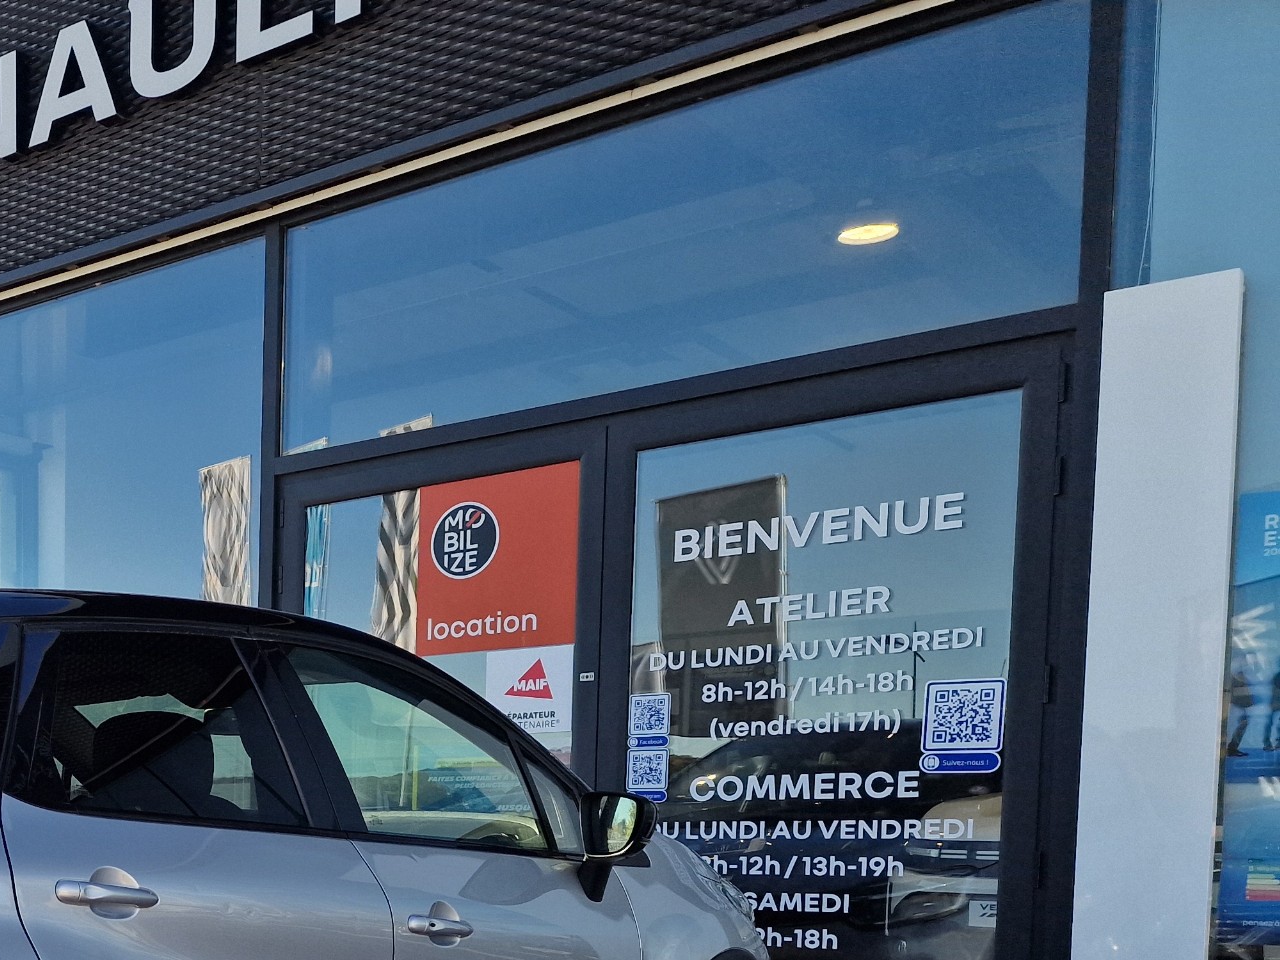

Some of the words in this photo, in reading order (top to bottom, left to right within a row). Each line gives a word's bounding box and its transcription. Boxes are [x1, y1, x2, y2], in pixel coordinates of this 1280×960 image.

[673, 492, 966, 564] BIENVENUE
[727, 586, 892, 628] ATELIER
[426, 610, 538, 641] location
[649, 650, 686, 672] DU
[691, 644, 772, 669] LUNDI
[778, 639, 820, 663] AU
[825, 627, 984, 660] VENDREDI
[512, 678, 549, 692] MAIF
[701, 678, 787, 704] 8h-12h
[810, 670, 914, 697] 14h-18h
[507, 710, 556, 721] ÉPARATEUR
[709, 713, 840, 741] (vendredi
[846, 708, 902, 737] 17h)
[942, 759, 985, 767] Suivez-nous
[689, 770, 921, 802] COMMERCE
[656, 820, 680, 841] U
[685, 820, 766, 841] LUNDI
[770, 819, 812, 841] AU
[818, 818, 974, 840] VENDREDI
[802, 855, 904, 878] 13h-19h
[743, 891, 850, 914] SAMEDI
